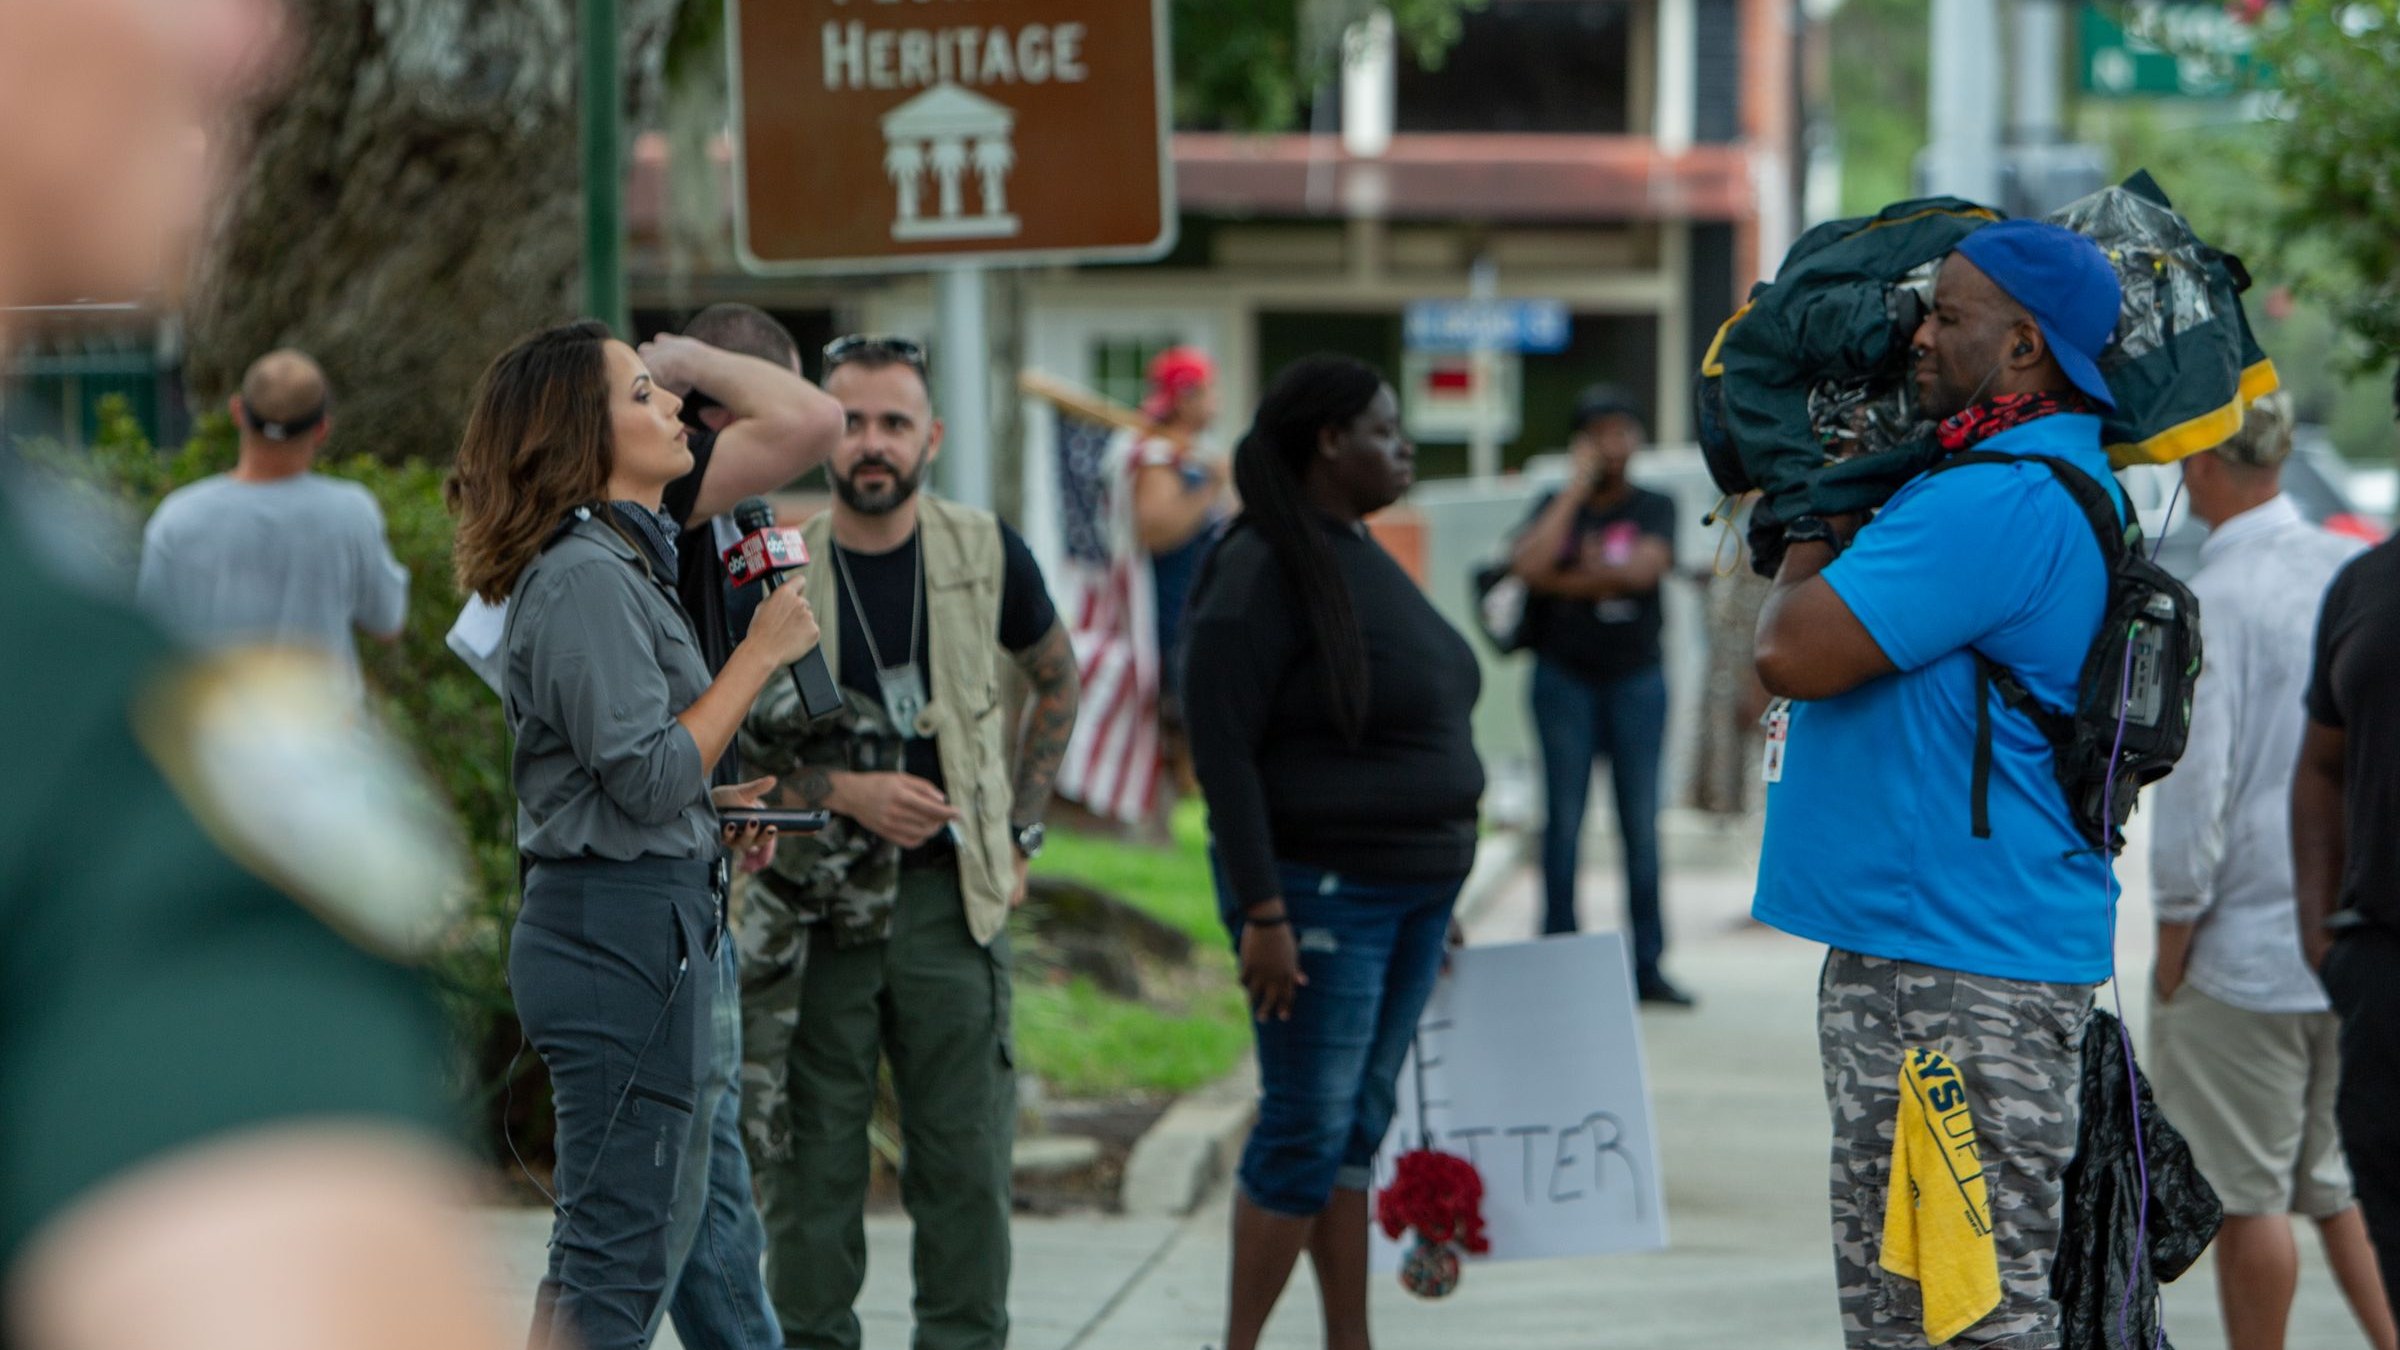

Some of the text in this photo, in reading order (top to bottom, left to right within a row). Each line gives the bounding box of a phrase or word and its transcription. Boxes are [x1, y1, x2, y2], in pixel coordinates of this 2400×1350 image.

[821, 19, 1088, 91] HERITAGE
[728, 554, 746, 574] abc
[1373, 1110, 1645, 1224] TTER
